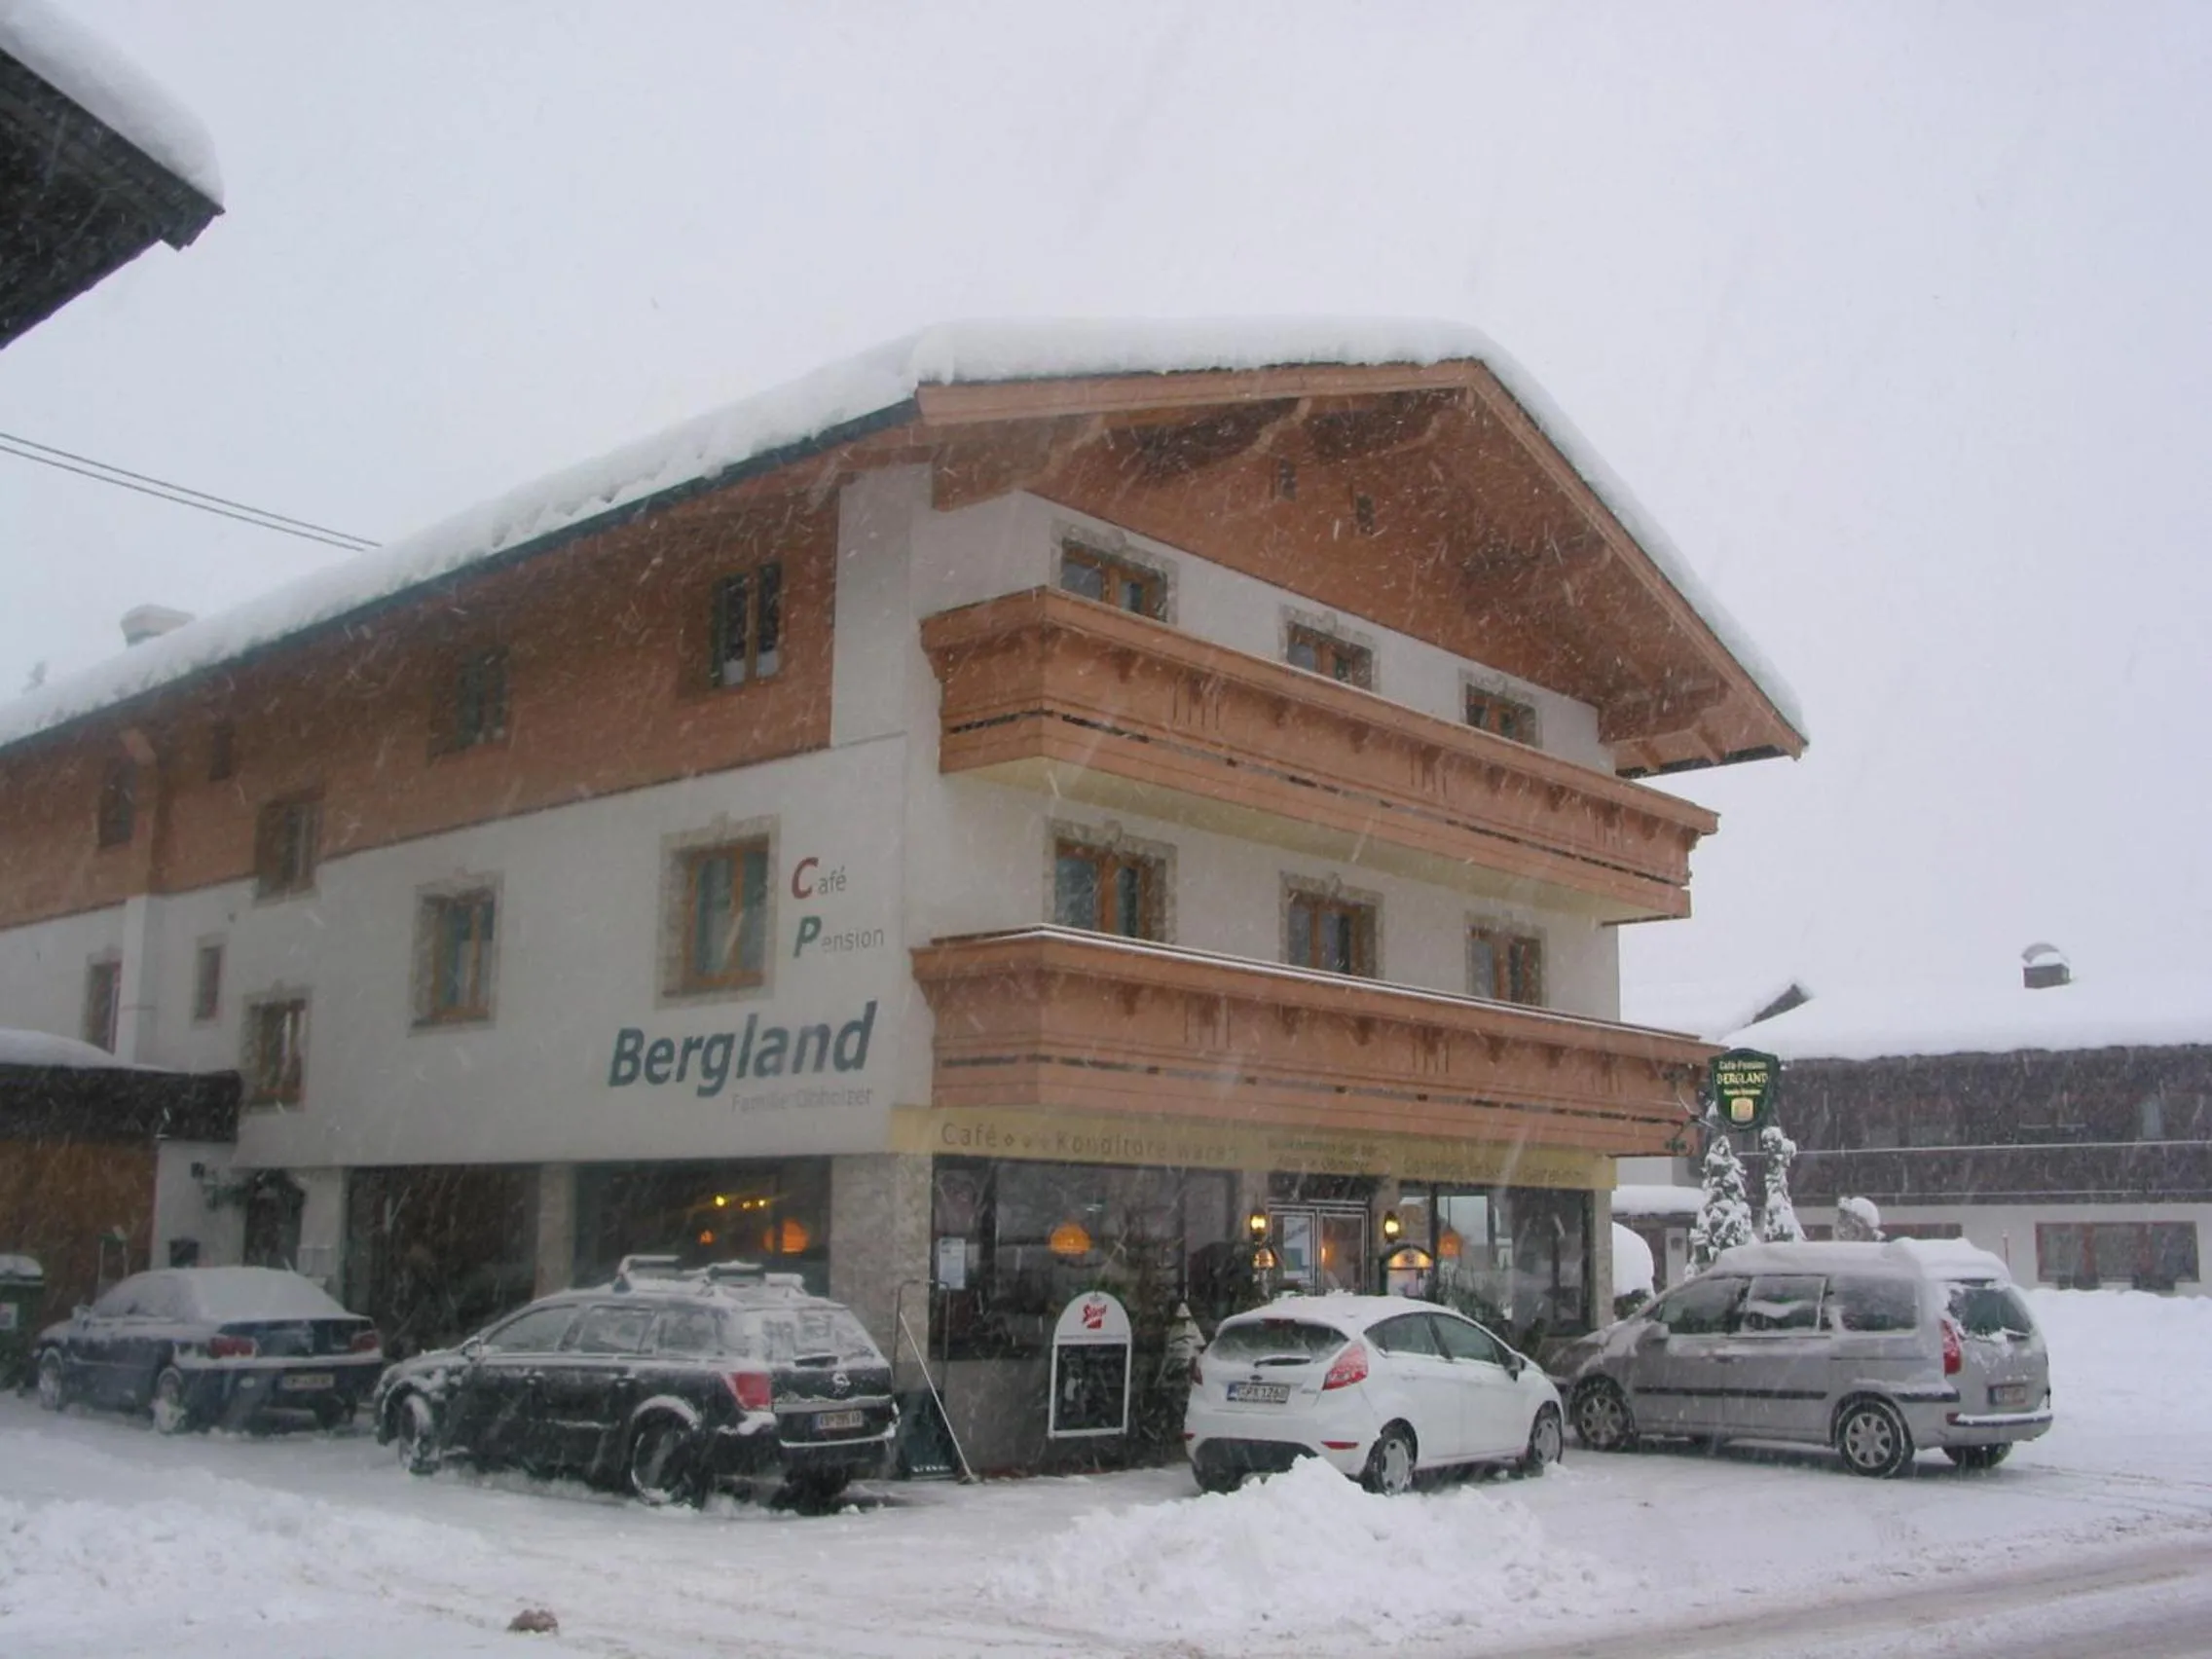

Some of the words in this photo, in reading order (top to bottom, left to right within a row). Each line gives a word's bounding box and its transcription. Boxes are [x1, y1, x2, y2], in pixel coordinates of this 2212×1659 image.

[791, 857, 847, 900] Café
[793, 915, 885, 958] Pension
[608, 999, 878, 1098] Bergland
[940, 1121, 997, 1148] Café
